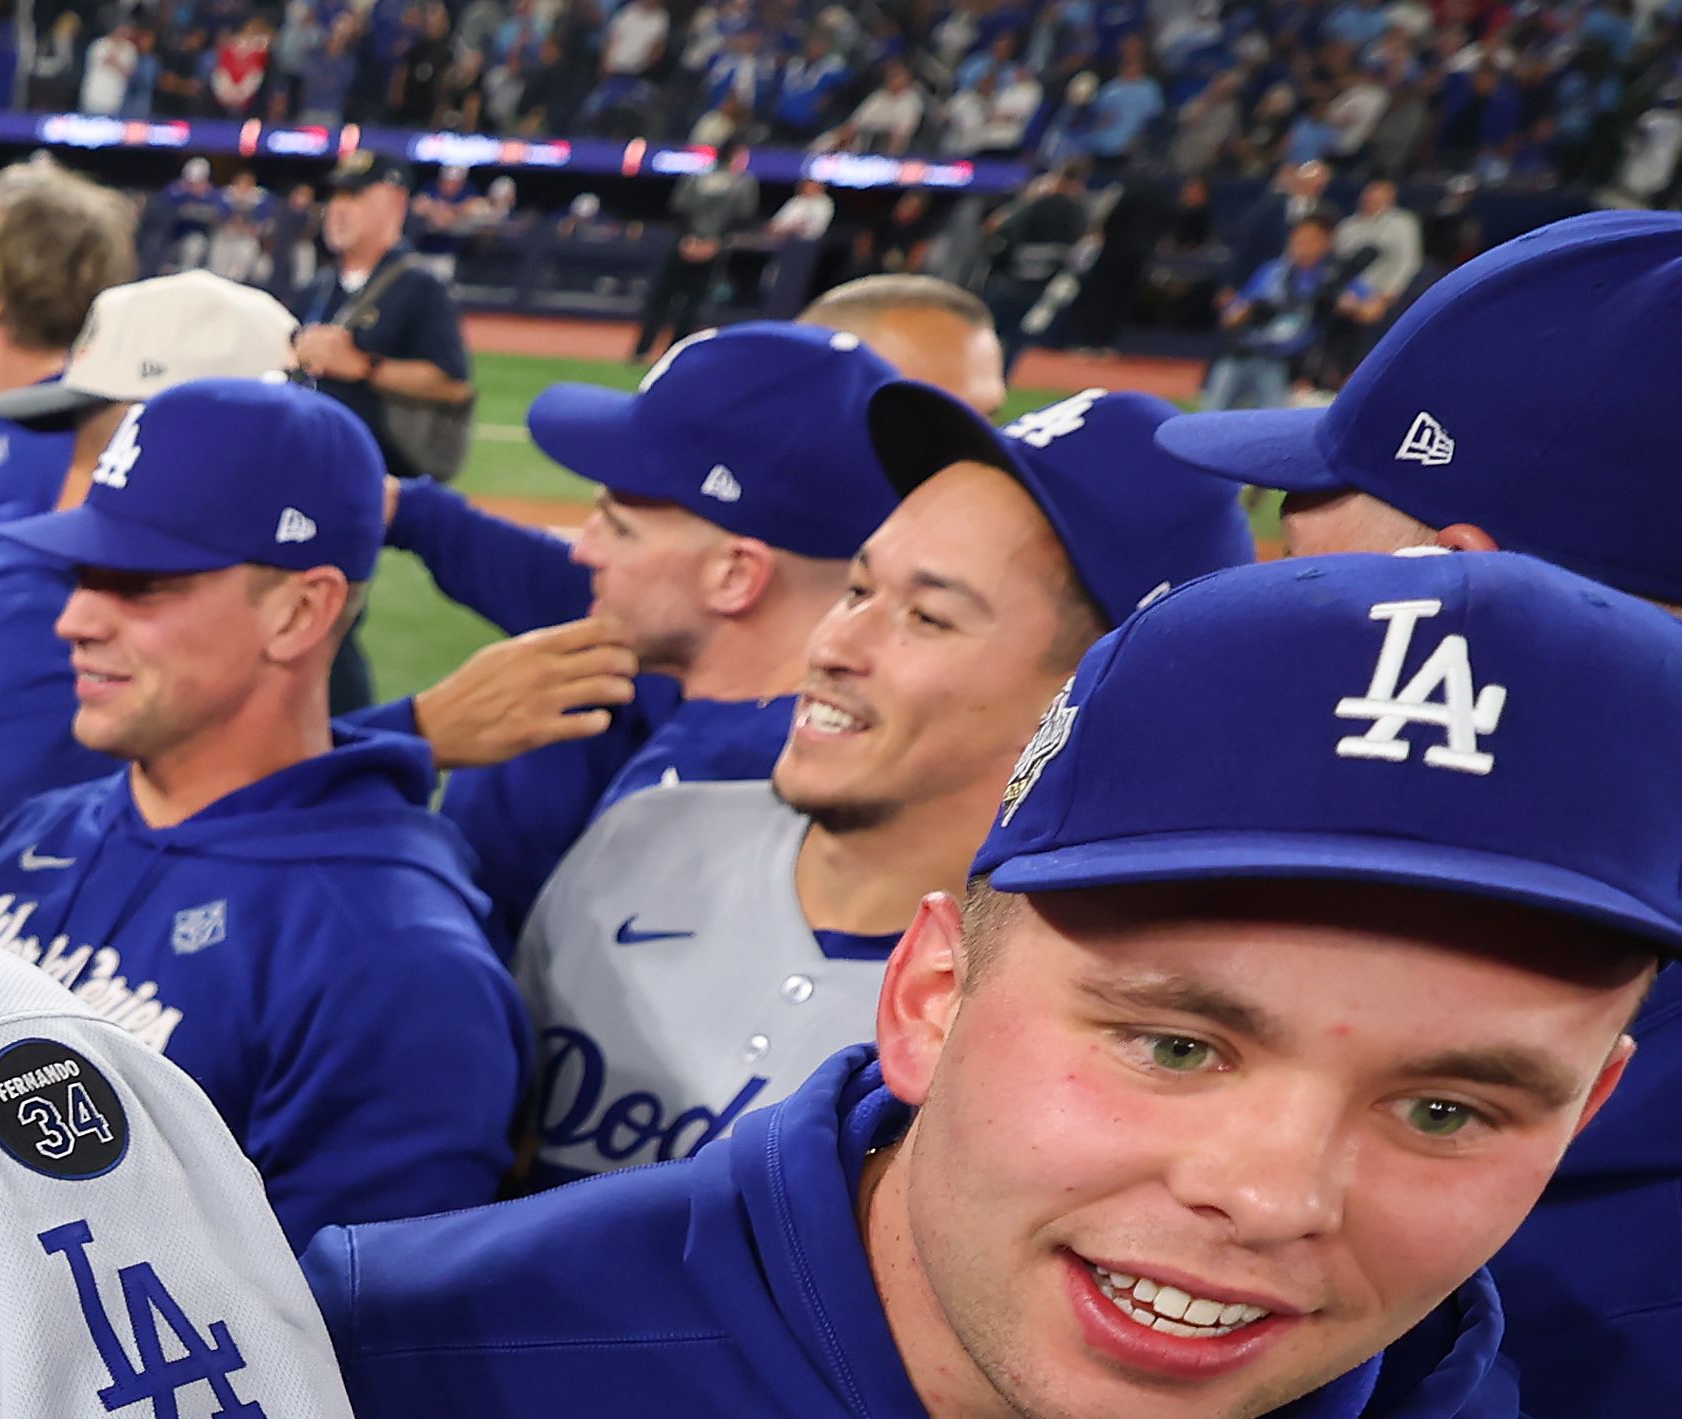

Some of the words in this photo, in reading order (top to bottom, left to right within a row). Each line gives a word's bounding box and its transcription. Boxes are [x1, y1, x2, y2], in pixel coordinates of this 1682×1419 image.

[92, 403, 148, 489] LA
[1334, 599, 1507, 775] LA
[17, 1082, 115, 1160] 34
